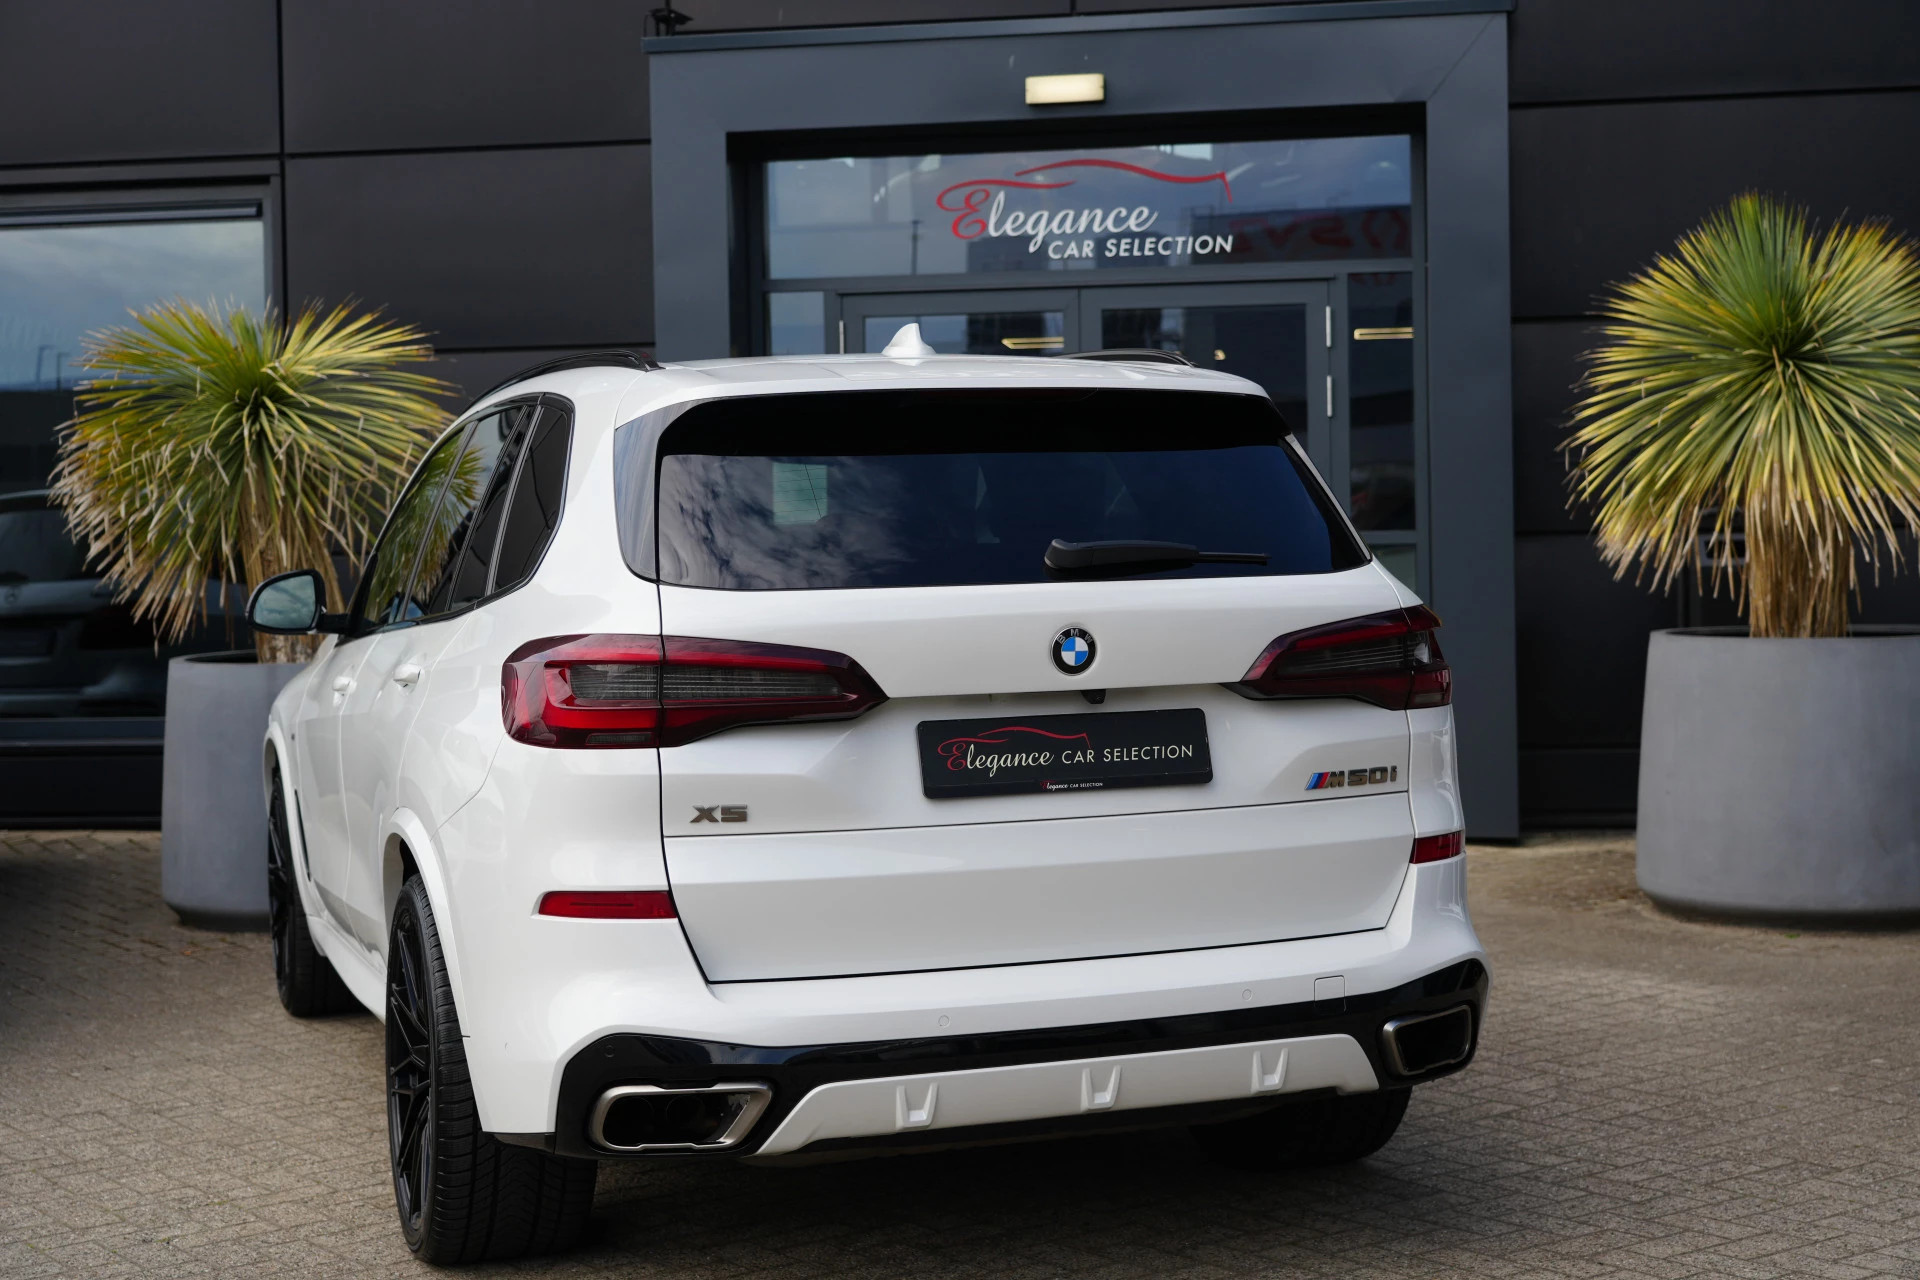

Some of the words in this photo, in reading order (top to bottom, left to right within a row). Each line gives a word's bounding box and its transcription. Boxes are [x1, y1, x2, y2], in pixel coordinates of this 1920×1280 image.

[937, 180, 1158, 253] Elegance
[1047, 240, 1095, 260] CAR
[1104, 235, 1233, 258] SELECTION
[1056, 628, 1093, 645] BMW
[938, 738, 1055, 778] Elegance
[1061, 749, 1095, 764] CAR
[1103, 744, 1193, 762] SELECTION
[689, 804, 748, 823] X5
